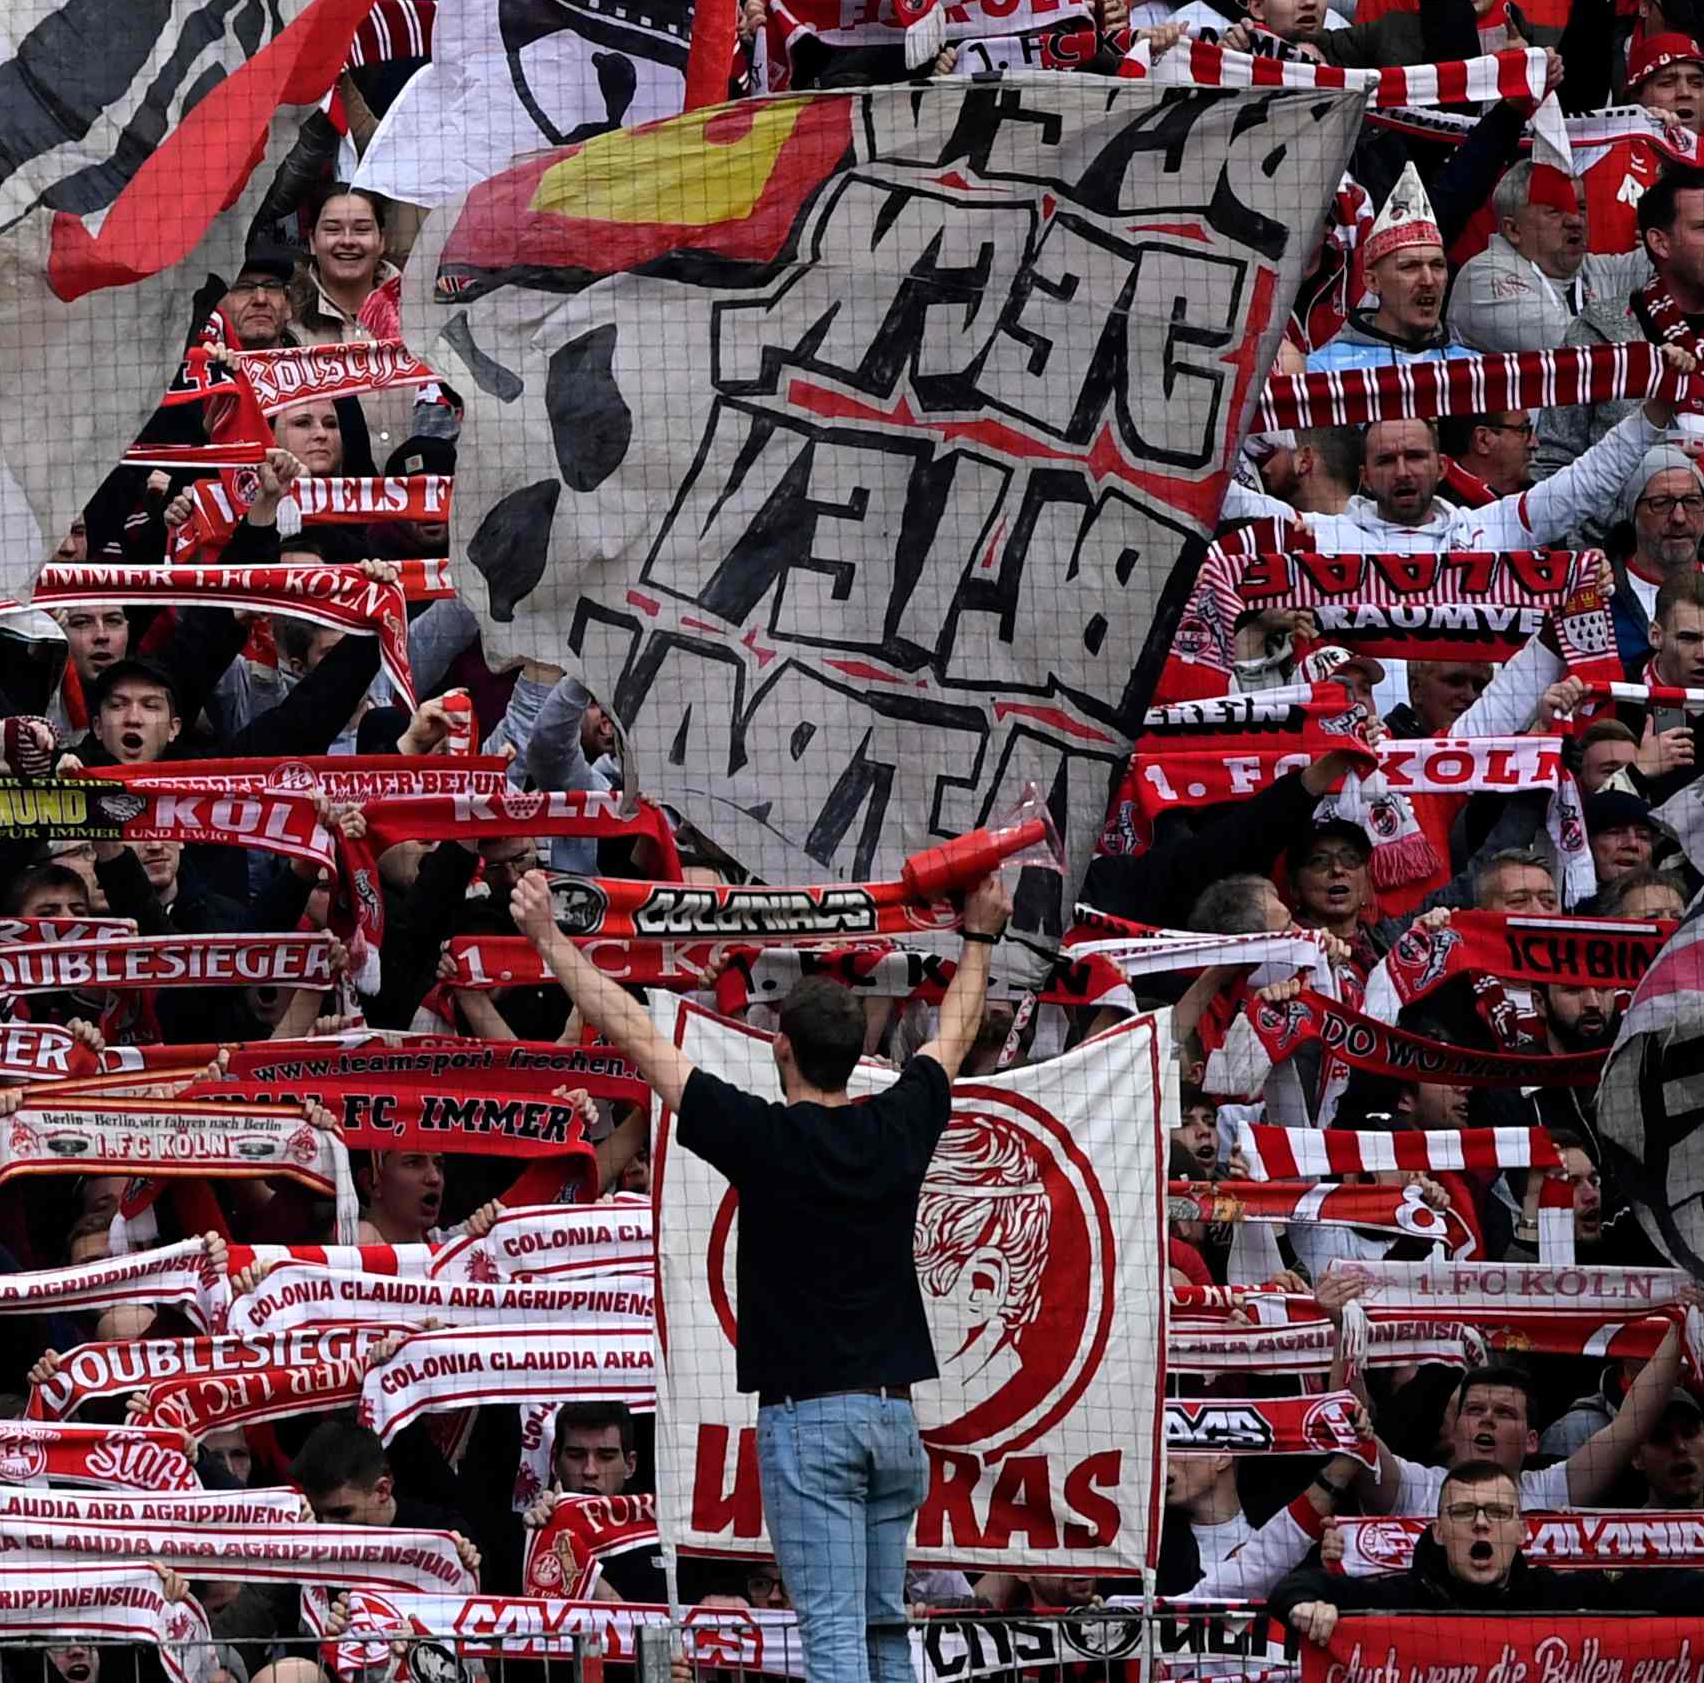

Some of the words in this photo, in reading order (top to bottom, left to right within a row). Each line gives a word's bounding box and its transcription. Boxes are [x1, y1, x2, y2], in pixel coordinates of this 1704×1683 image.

[1146, 762, 1206, 799] 1.
[345, 1095, 403, 1137] FC,
[421, 1095, 572, 1141] IMMER
[158, 1128, 231, 1159] KÖLN
[504, 1228, 610, 1257] COLONIA
[340, 1281, 442, 1305] CLAUDIA
[449, 1286, 495, 1307] ARA
[1450, 1271, 1503, 1294] FC
[1519, 1265, 1658, 1299] KÖLN
[382, 1352, 484, 1395] COLONIA
[490, 1351, 598, 1373] CLAUDIA
[692, 1424, 1121, 1548] URAS
[83, 1499, 131, 1519] ARA
